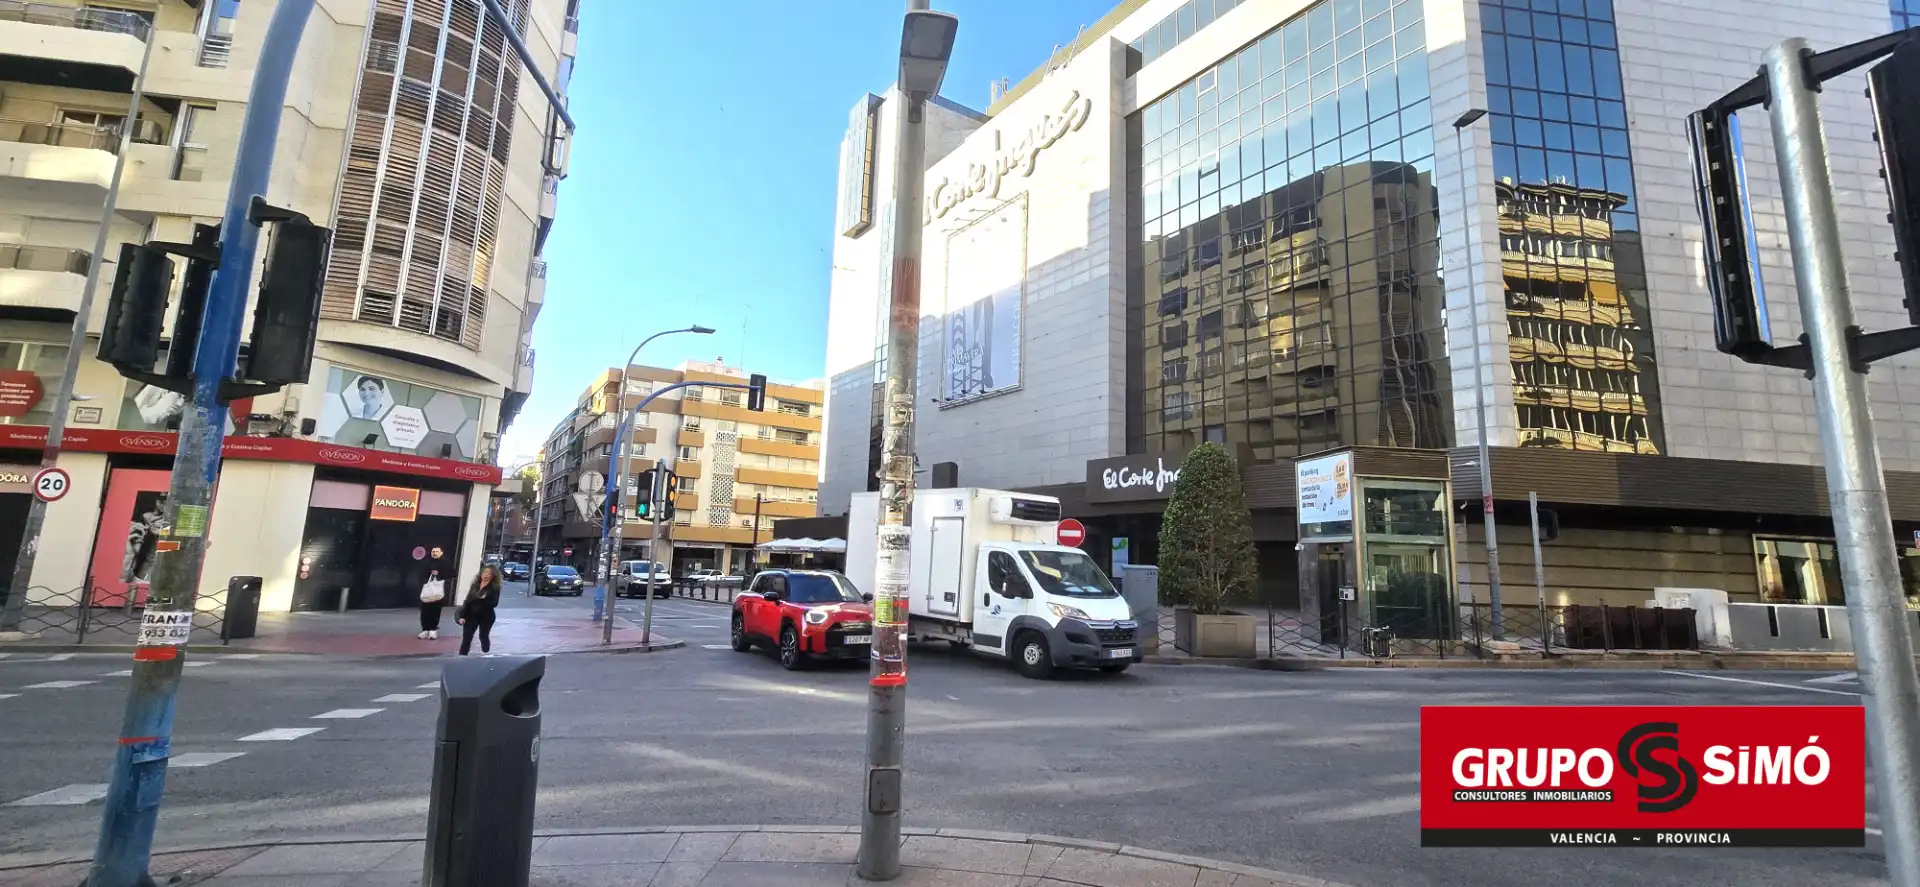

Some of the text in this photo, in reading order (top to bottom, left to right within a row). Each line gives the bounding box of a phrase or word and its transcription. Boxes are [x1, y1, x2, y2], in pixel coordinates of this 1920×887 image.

[123, 437, 165, 447] SVENSON
[325, 450, 361, 461] SVENSON
[458, 468, 487, 477] SVENSON
[1103, 468, 1118, 489] El
[1118, 466, 1154, 488] Corte
[41, 478, 63, 490] 20
[375, 498, 415, 509] PANDORA
[143, 614, 189, 624] FRAN
